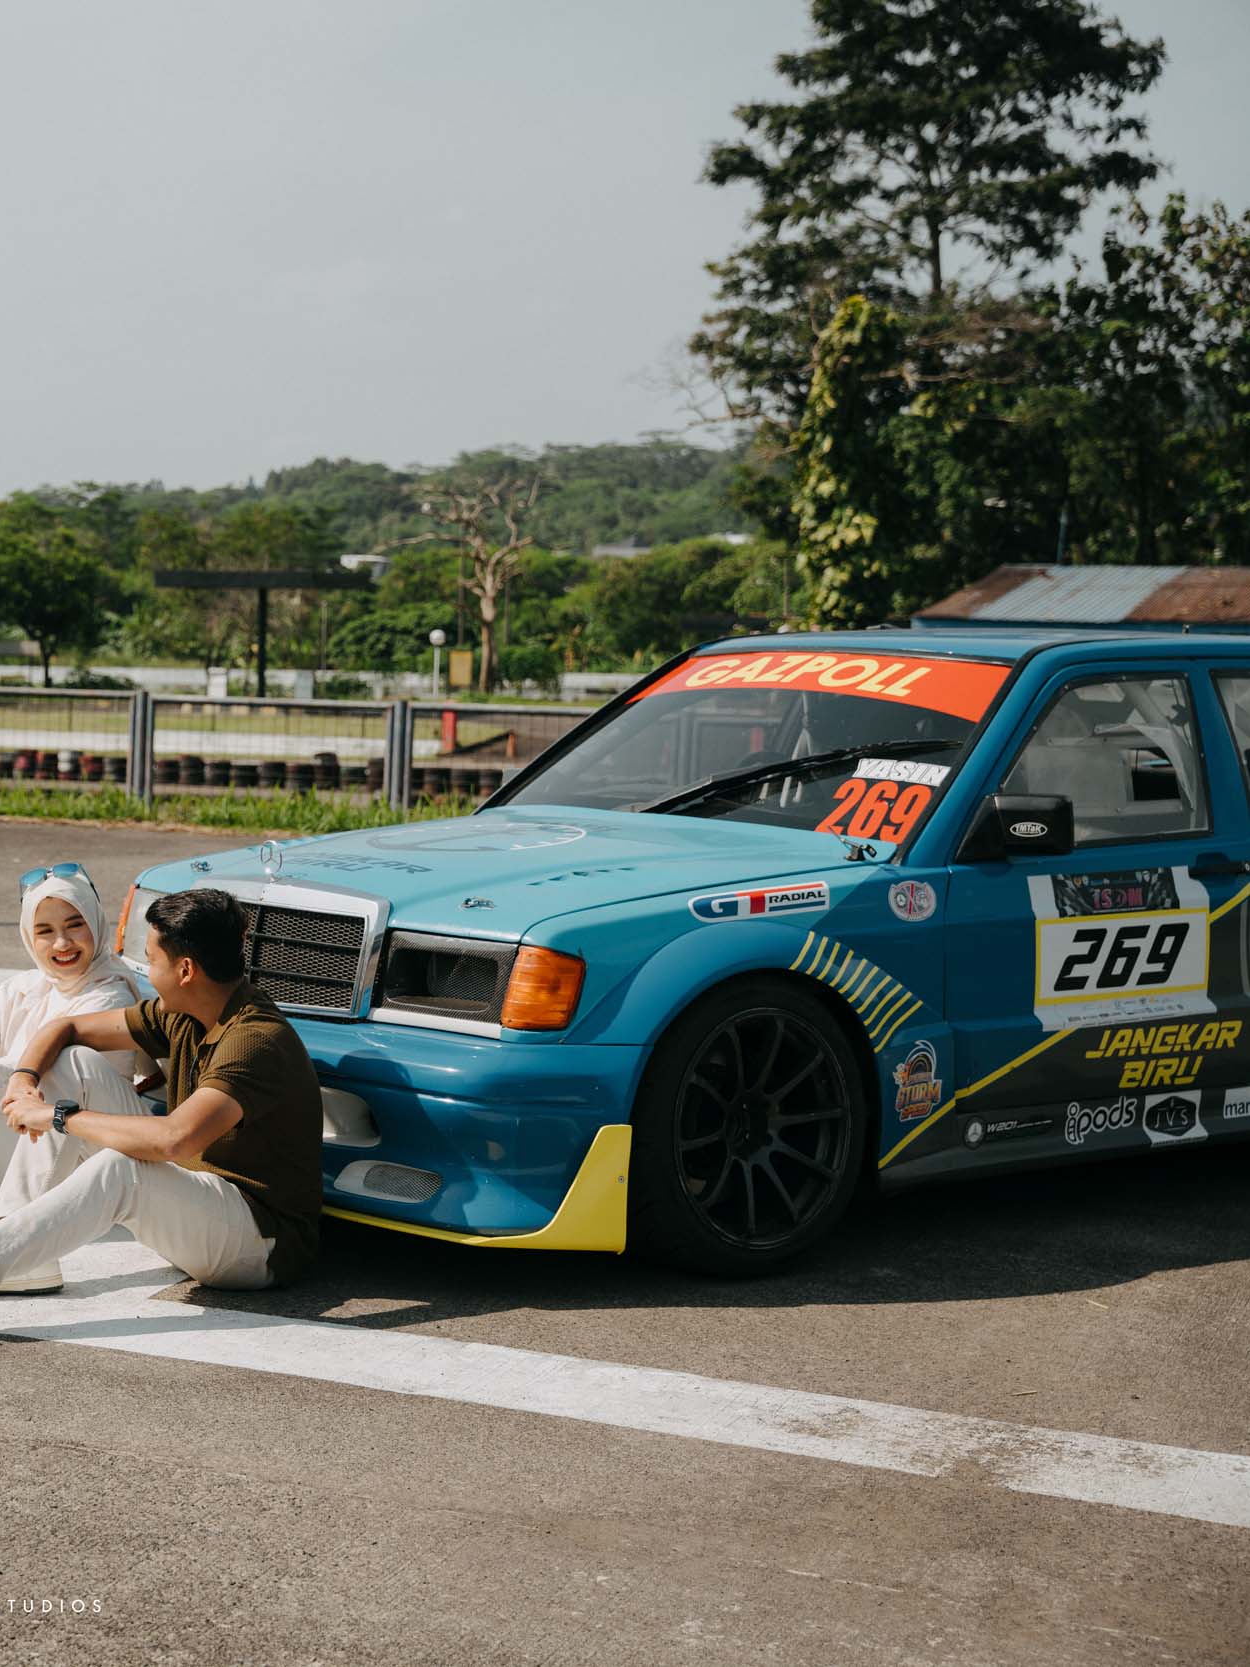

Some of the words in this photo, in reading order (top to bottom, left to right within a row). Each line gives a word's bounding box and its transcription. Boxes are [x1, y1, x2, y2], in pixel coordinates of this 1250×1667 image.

[685, 655, 931, 697] GAZPOLL
[852, 758, 952, 787] YASIN
[816, 779, 933, 845] 269
[692, 888, 766, 919] GT
[768, 890, 827, 904] RADIAL
[1053, 922, 1190, 992] 269
[1085, 1020, 1243, 1059] JANGKAR
[1118, 1056, 1204, 1089] BIRU
[986, 1120, 1018, 1133] W201
